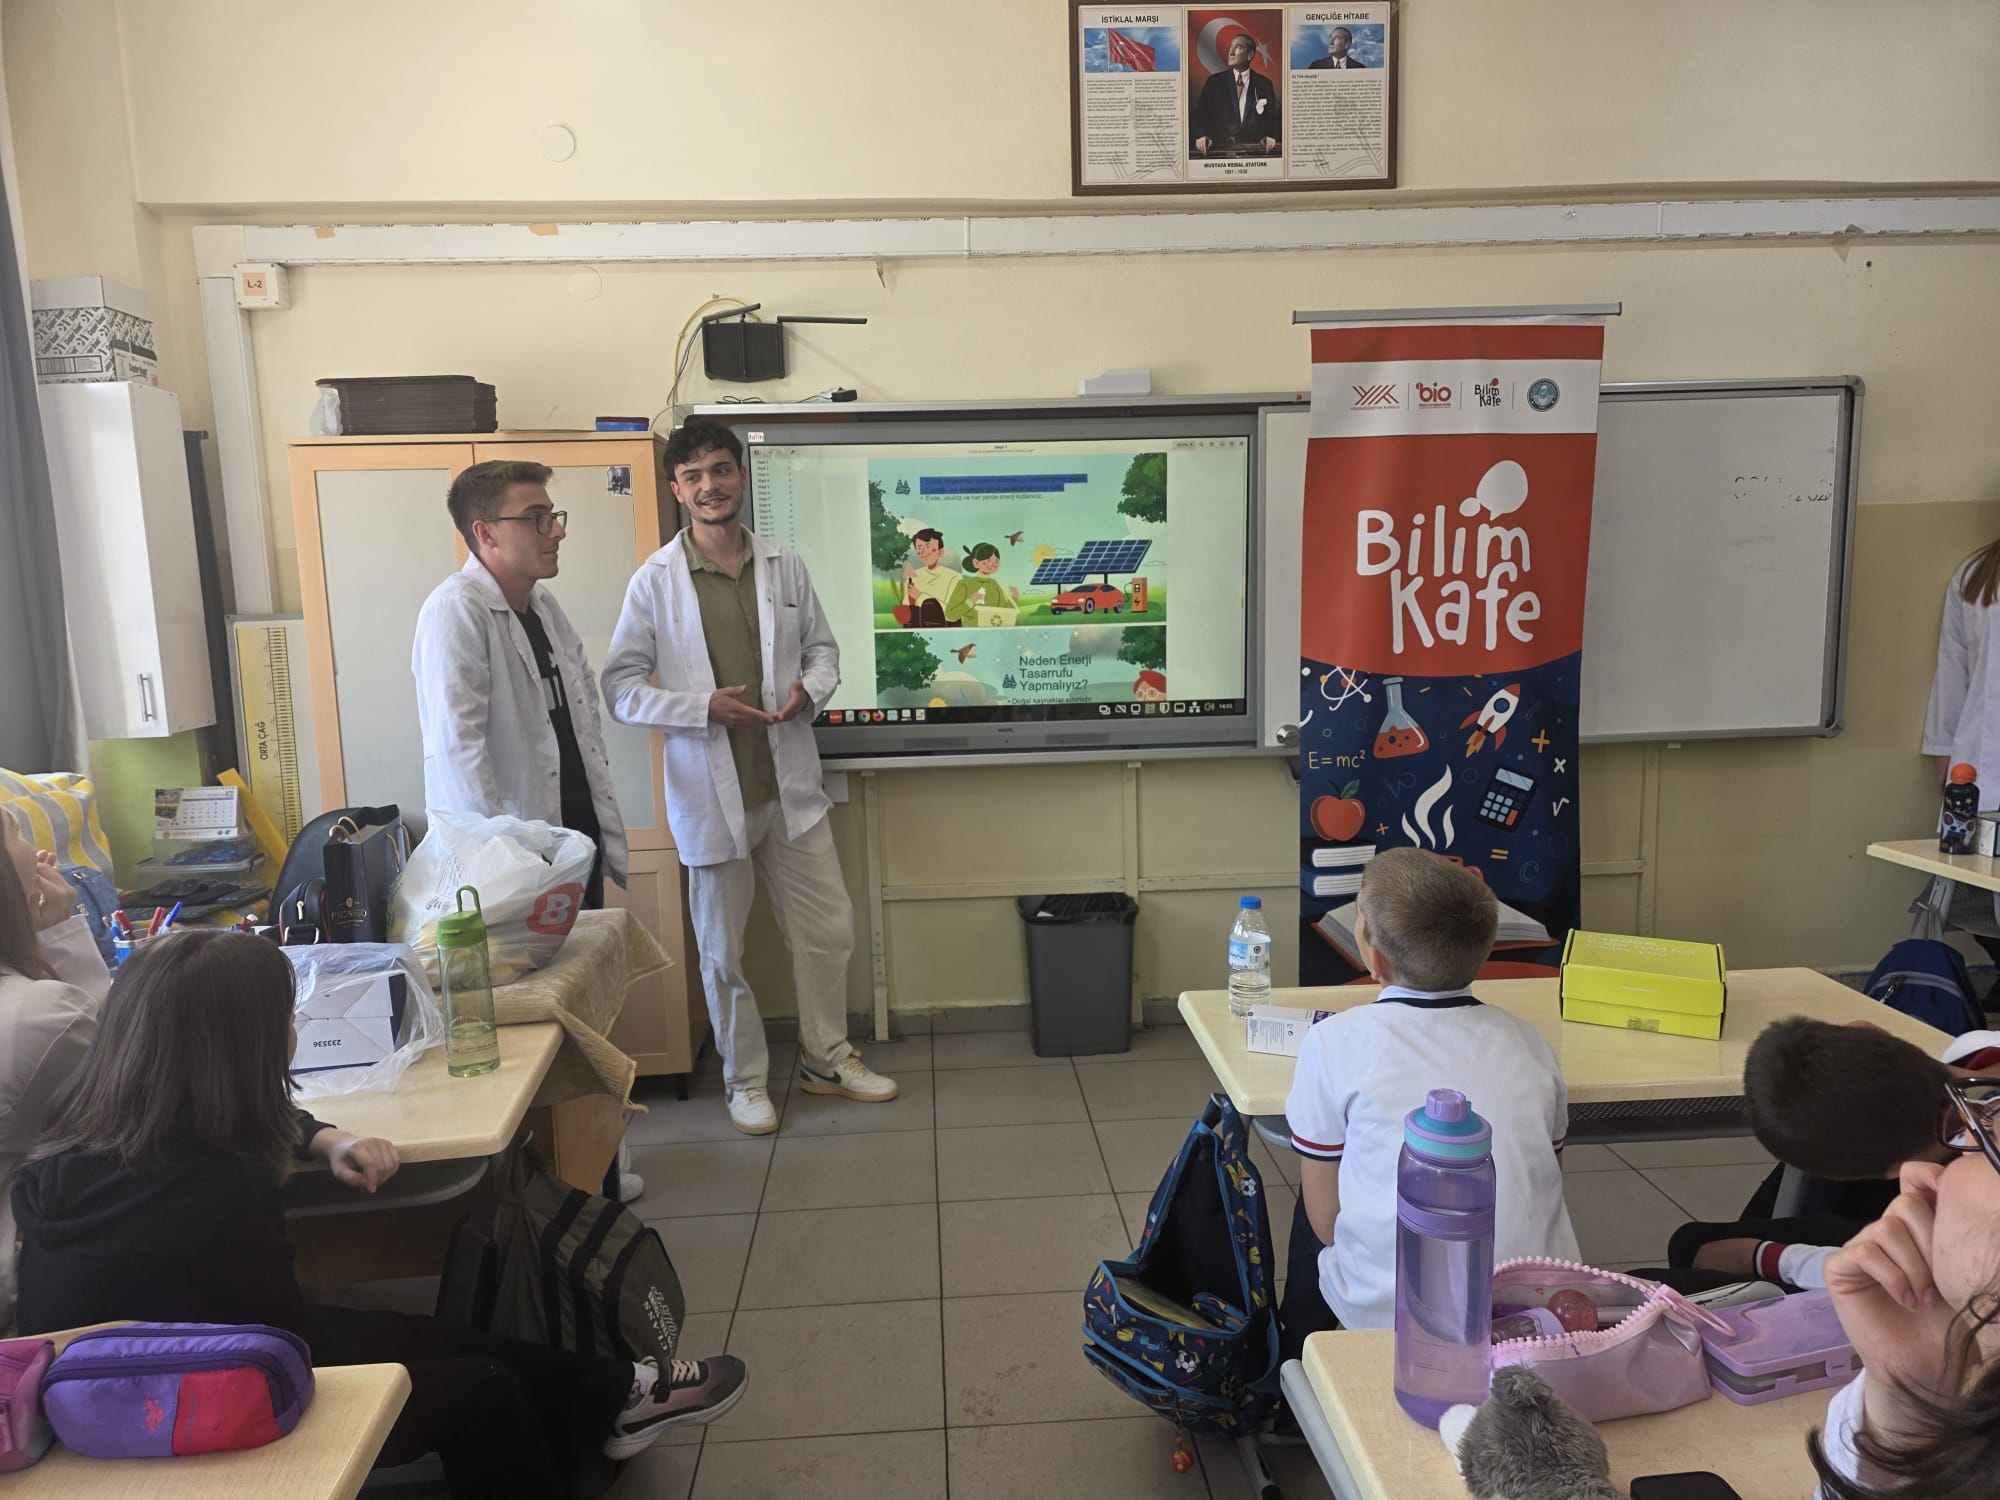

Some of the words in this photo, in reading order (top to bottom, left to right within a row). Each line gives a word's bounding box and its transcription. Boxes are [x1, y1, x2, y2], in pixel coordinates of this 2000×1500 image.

[1101, 14, 1134, 24] İSTİKLAL
[1135, 15, 1159, 23] MARŞI
[1305, 11, 1342, 22] GENÇLİĞE
[1343, 11, 1370, 20] HİTABE
[247, 279, 263, 289] L-2
[1418, 382, 1452, 402] bio
[1474, 383, 1500, 396] Bilim
[1479, 393, 1501, 408] Kafe
[1356, 497, 1531, 579] Bilim
[1390, 561, 1541, 655] Kafe
[1019, 656, 1056, 666] Neden
[1059, 654, 1092, 667] Enerji
[1019, 667, 1073, 679] Tasarrufu
[1019, 679, 1088, 693] Yapmalıyız?
[254, 721, 269, 740] ÇAĞ
[258, 740, 269, 760] ORTA
[331, 908, 367, 921] PICASSO
[540, 893, 572, 925] B
[312, 1039, 342, 1048] 233536
